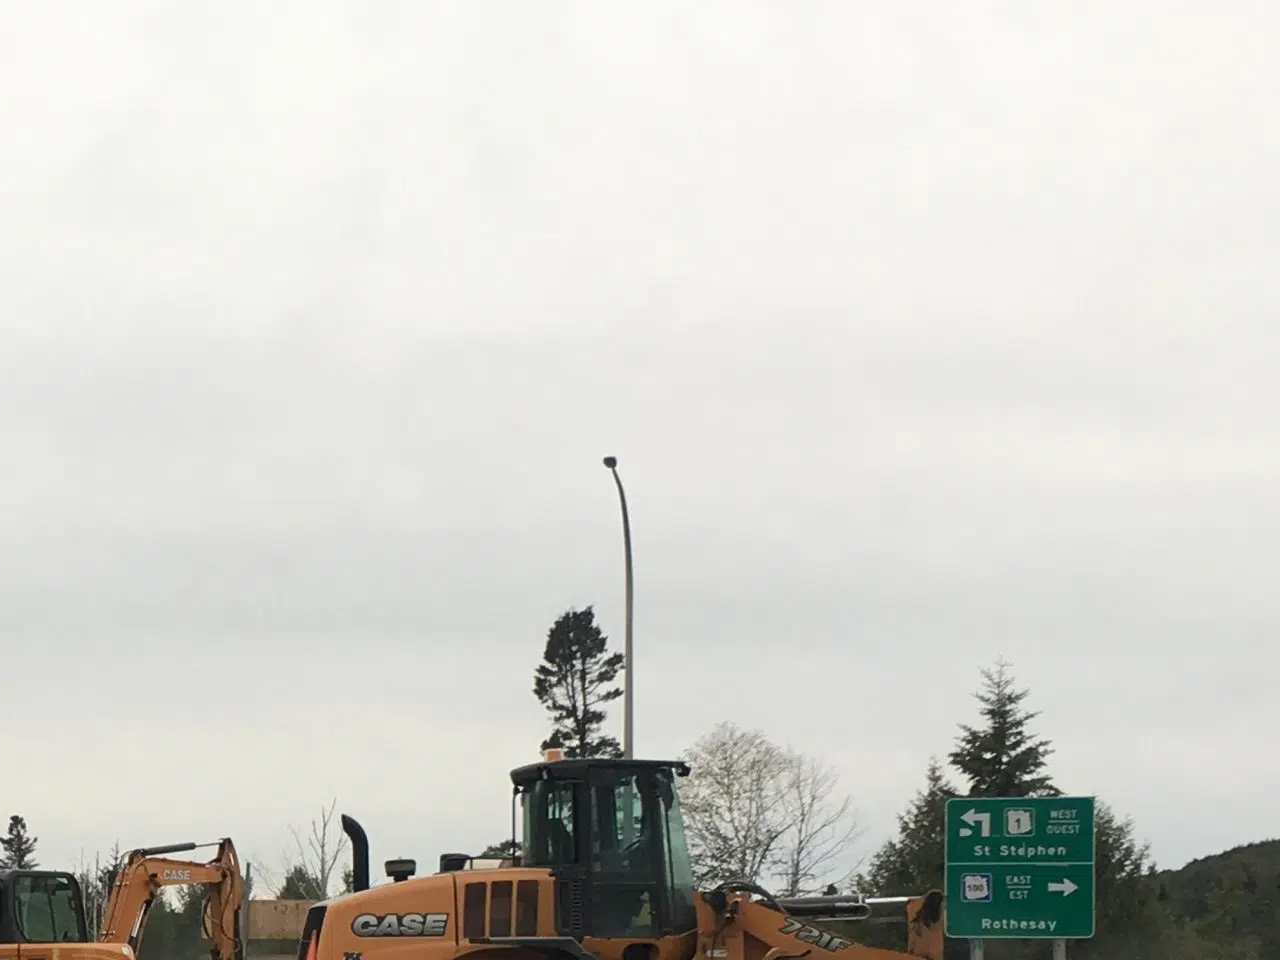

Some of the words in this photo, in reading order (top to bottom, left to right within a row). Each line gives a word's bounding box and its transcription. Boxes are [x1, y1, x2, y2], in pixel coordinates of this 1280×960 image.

[1050, 809, 1078, 819] WEST
[1014, 818, 1022, 829] 1
[1046, 825, 1081, 834] OUEST
[973, 845, 991, 856] St
[163, 869, 191, 880] CASE
[1005, 876, 1032, 884] EAST
[967, 883, 984, 892] 100
[1009, 890, 1029, 899] EST
[351, 912, 449, 937] CASE
[981, 918, 1057, 931] Rothesay
[778, 917, 852, 949] 721F
